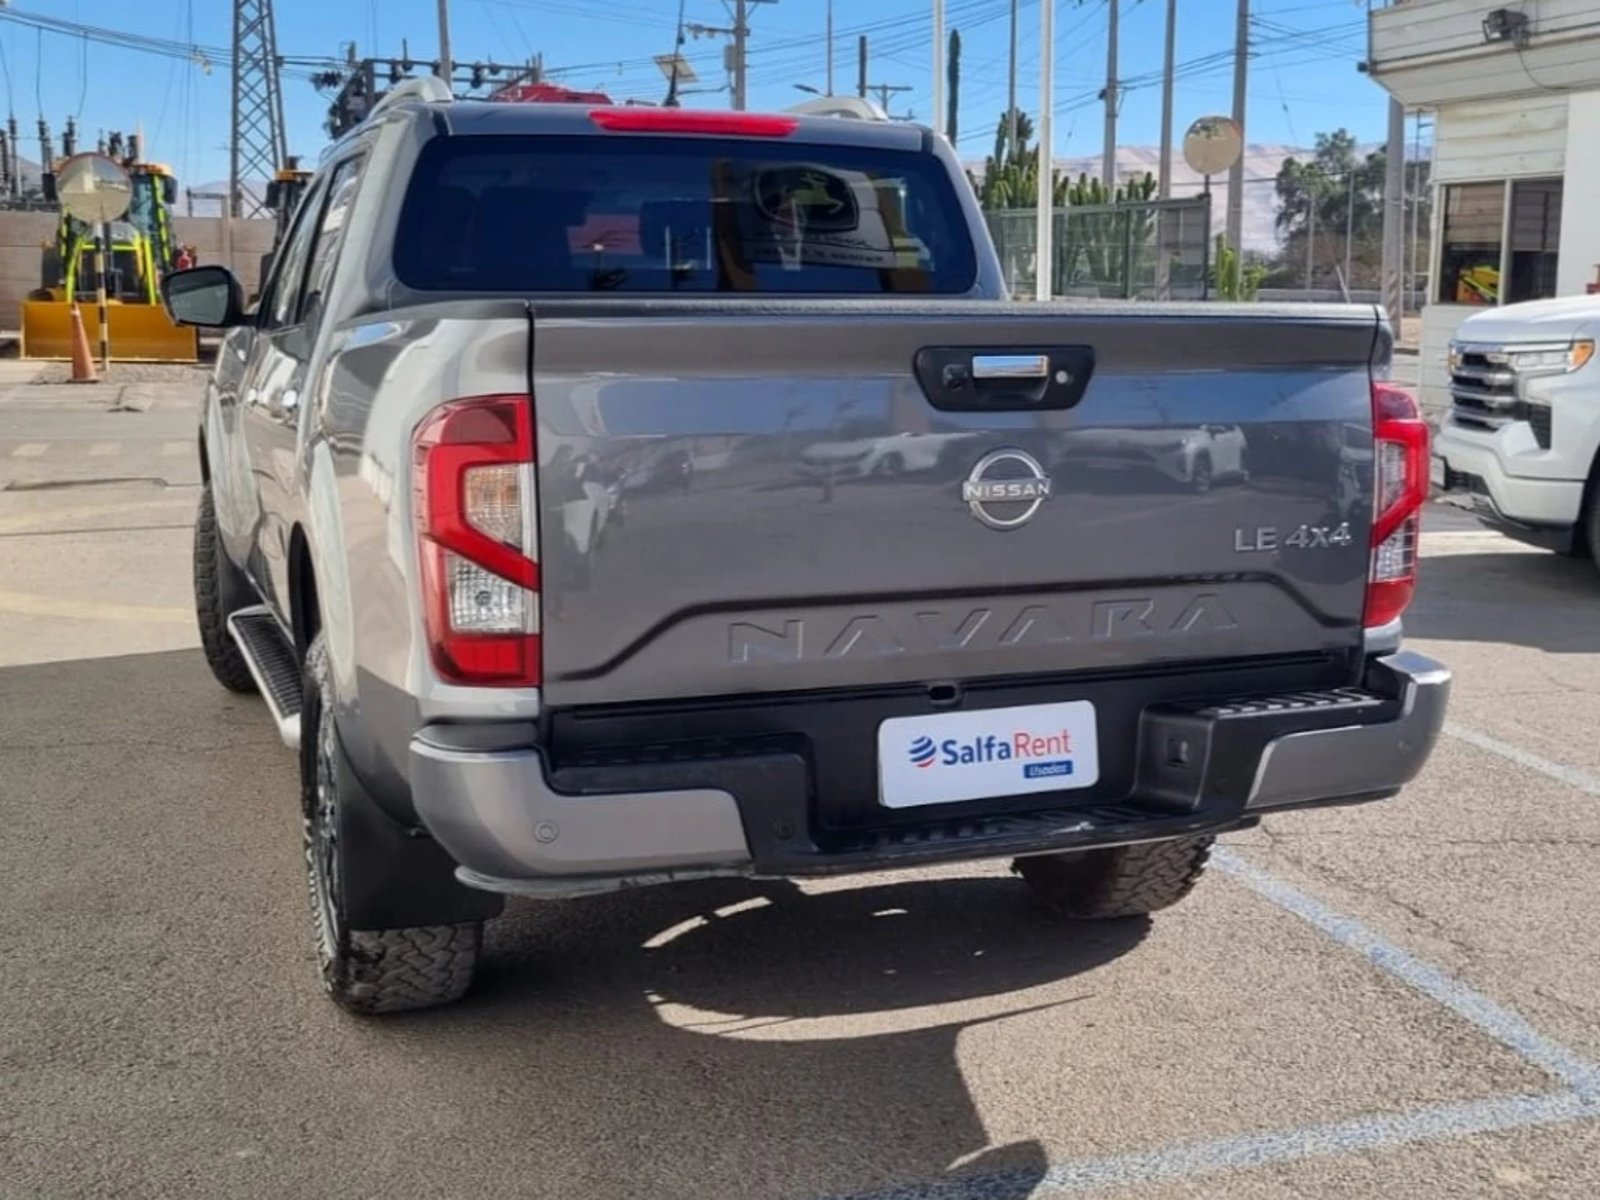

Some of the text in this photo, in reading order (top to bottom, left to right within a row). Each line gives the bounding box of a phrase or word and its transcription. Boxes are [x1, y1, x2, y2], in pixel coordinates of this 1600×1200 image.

[965, 482, 1050, 498] NISSAN
[1235, 521, 1352, 551] LE 4x4
[727, 594, 1239, 664] NAVARA
[941, 729, 1073, 766] SalfaRent
